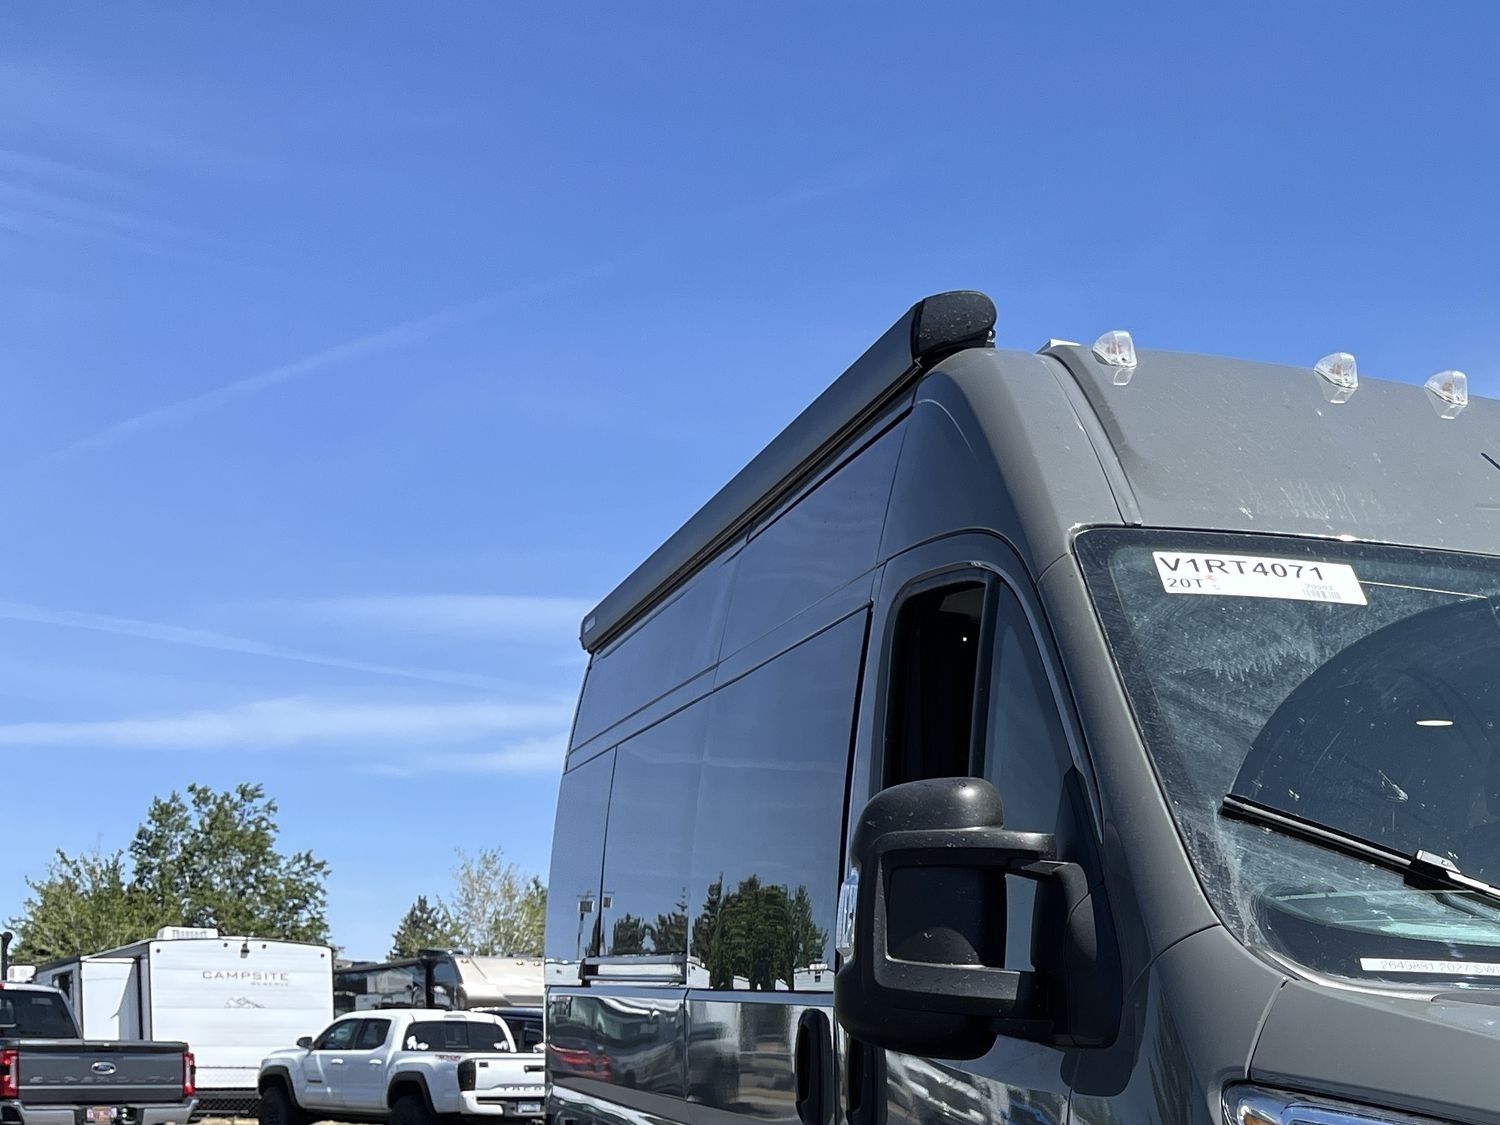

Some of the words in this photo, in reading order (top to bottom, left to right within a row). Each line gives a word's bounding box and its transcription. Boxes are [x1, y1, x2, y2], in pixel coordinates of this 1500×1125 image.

[1159, 556, 1326, 581] V1RT4071
[1167, 577, 1204, 589] 20T
[202, 970, 289, 981] CAMPSITE
